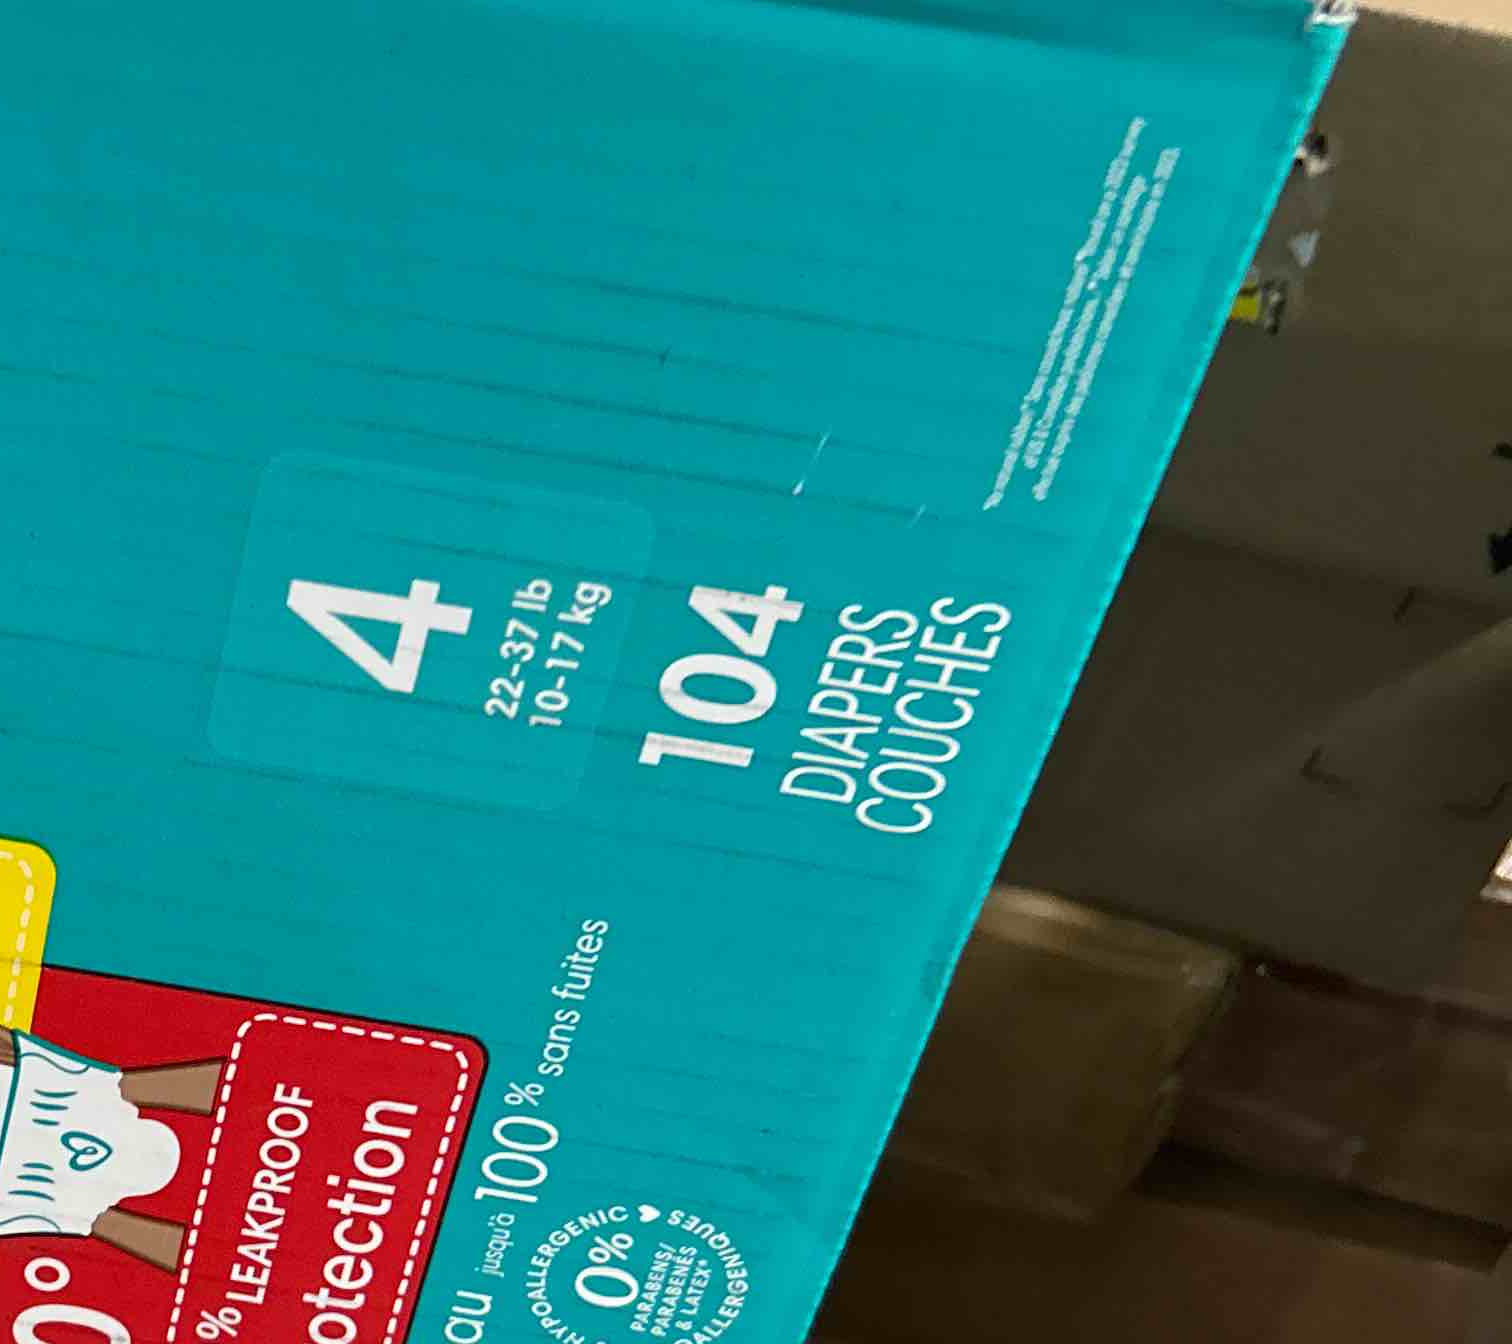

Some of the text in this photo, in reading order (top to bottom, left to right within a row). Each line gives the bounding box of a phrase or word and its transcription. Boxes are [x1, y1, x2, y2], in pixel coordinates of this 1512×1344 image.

[285, 577, 473, 693] 4
[484, 577, 553, 717] 22-37 lb
[528, 579, 613, 728] 10-17 kg
[638, 583, 805, 765] 104
[778, 602, 920, 801] DIAPERS
[855, 595, 1014, 833] COUCHES
[551, 918, 609, 1000] fuites
[538, 1008, 581, 1076] sans
[226, 1081, 314, 1304] LEAKPROOF
[474, 1211, 516, 1277] jusqu'à
[574, 1232, 639, 1307] 0%
